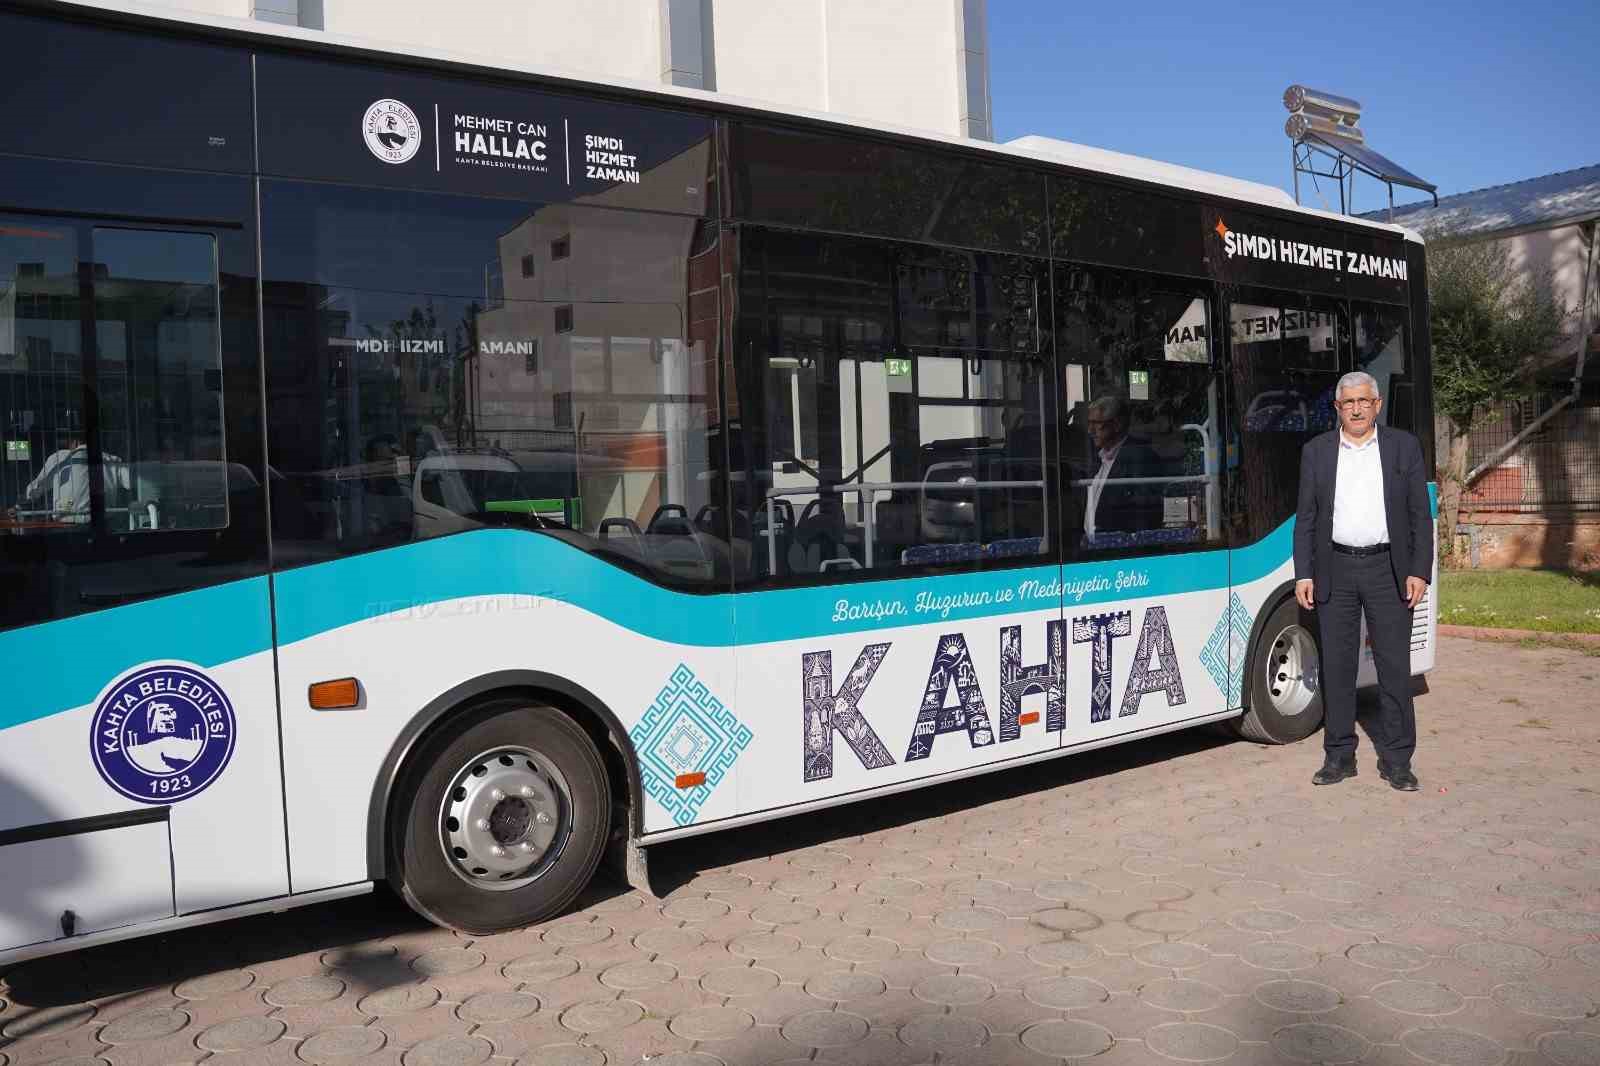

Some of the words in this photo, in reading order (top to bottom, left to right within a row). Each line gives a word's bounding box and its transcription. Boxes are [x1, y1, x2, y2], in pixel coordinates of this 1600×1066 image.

[454, 113, 514, 133] MEHMET
[517, 121, 547, 138] CAN
[586, 165, 640, 184] ZAMANI
[1279, 239, 1344, 272] HİZMET
[1346, 252, 1408, 281] ZAMANI
[480, 341, 533, 354] AMANI
[832, 599, 909, 622] Barışın,
[914, 590, 994, 618] Huzurun
[995, 587, 1015, 603] ve
[1018, 574, 1112, 602] Medeniyetin
[1114, 569, 1150, 592] Şehri
[801, 605, 1187, 783] KAHTA
[103, 692, 139, 754] KAHTA
[138, 677, 227, 739] BELEDİYESİ
[149, 774, 192, 793] 1923
